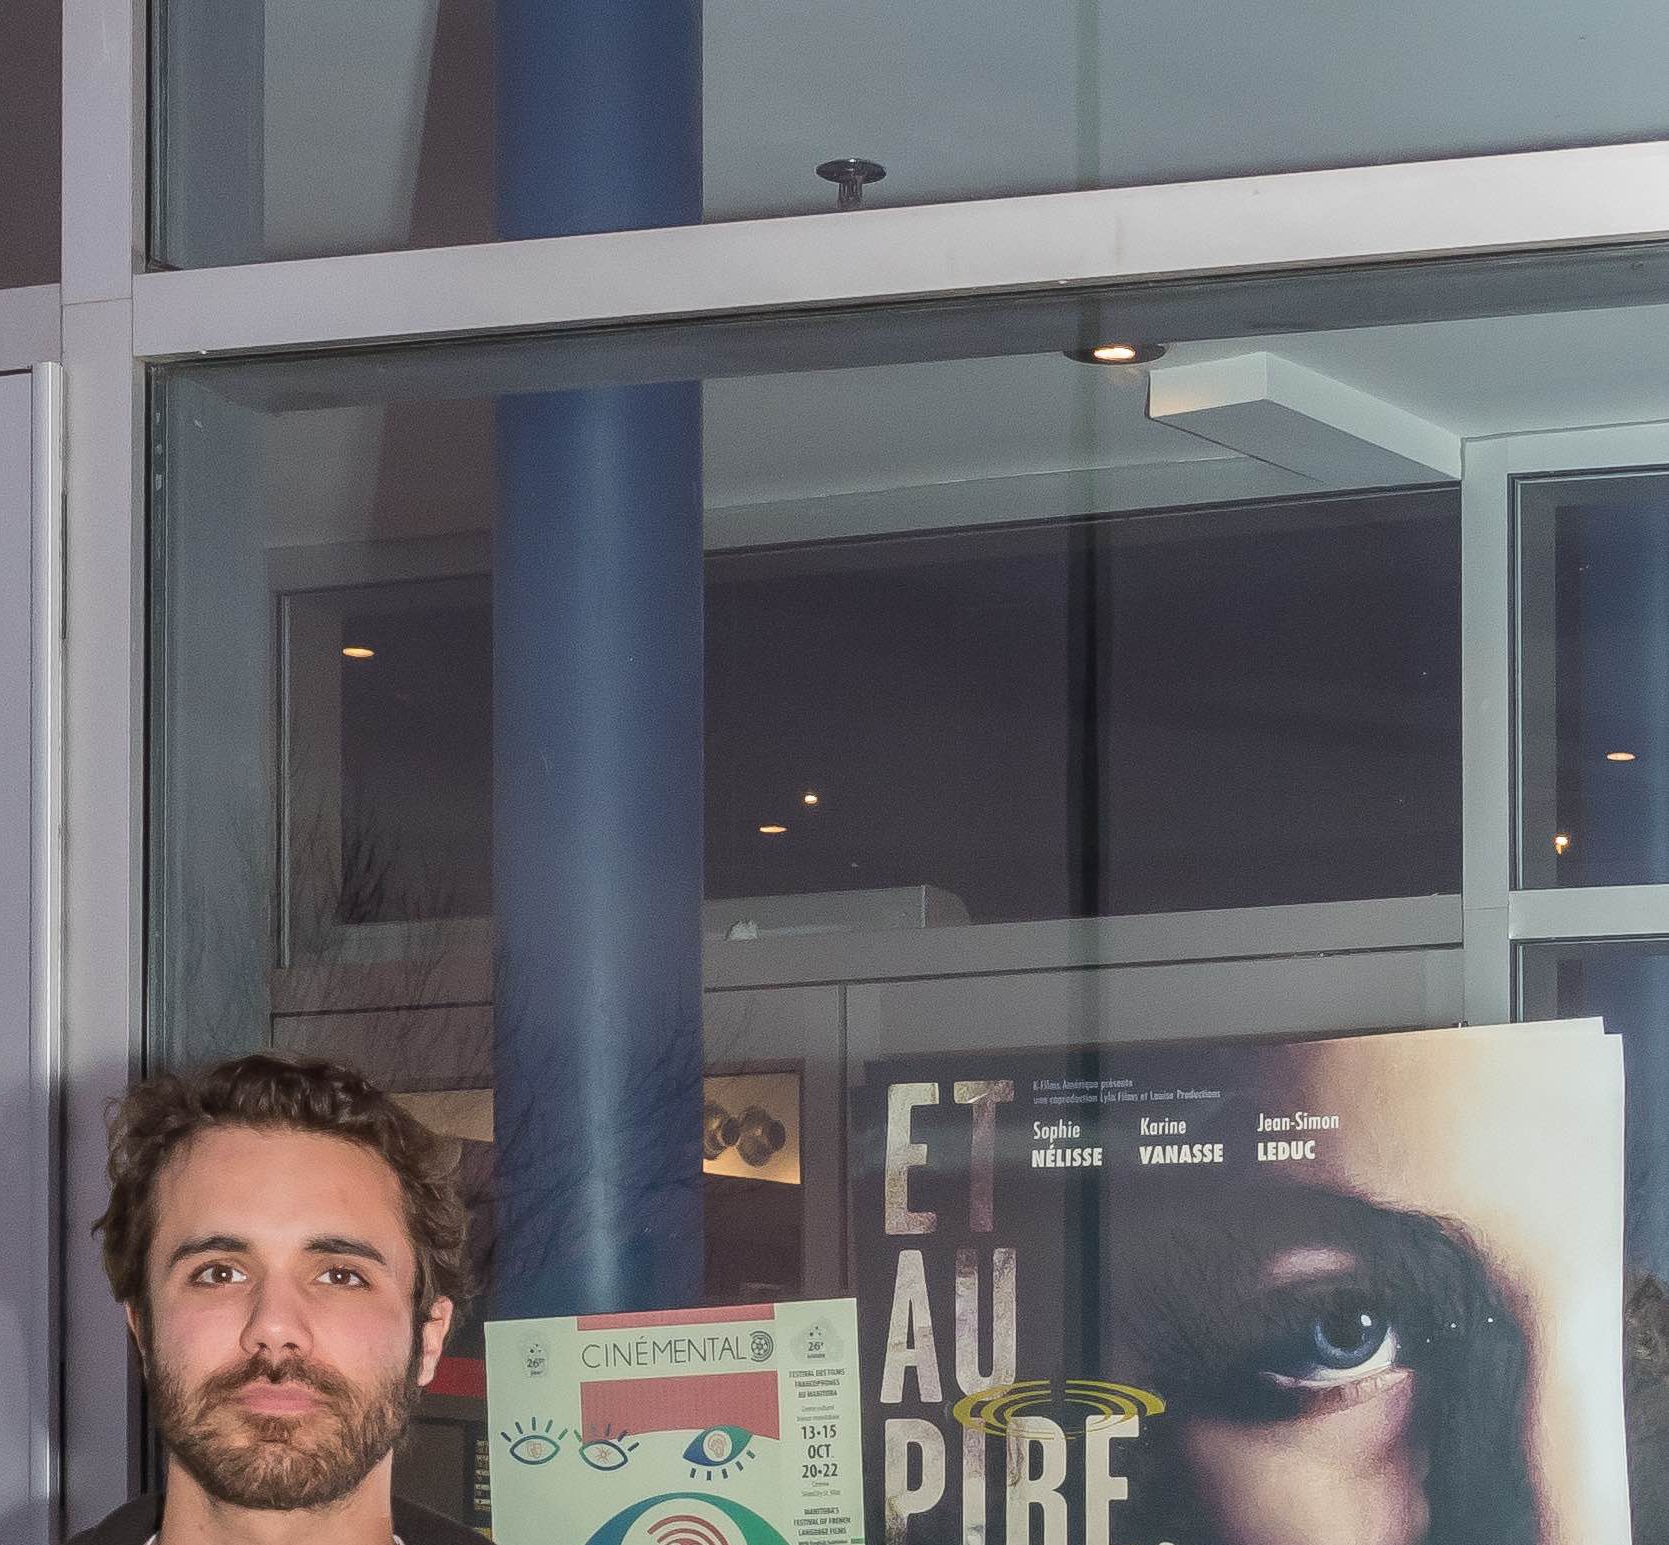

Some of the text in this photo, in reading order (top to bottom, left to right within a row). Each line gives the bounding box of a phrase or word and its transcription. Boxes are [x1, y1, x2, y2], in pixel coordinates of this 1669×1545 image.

[1032, 1119, 1081, 1143] Sophie
[1140, 1117, 1187, 1136] Karine
[1257, 1112, 1339, 1133] Jean-Simon
[884, 1079, 1015, 1235] ET
[1031, 1143, 1103, 1168] NÉLISSE
[1139, 1144, 1224, 1165] VANASSE
[1257, 1140, 1316, 1161] LEDUC
[879, 1247, 1017, 1404] AU
[581, 1335, 746, 1370] CINÉMENTAL
